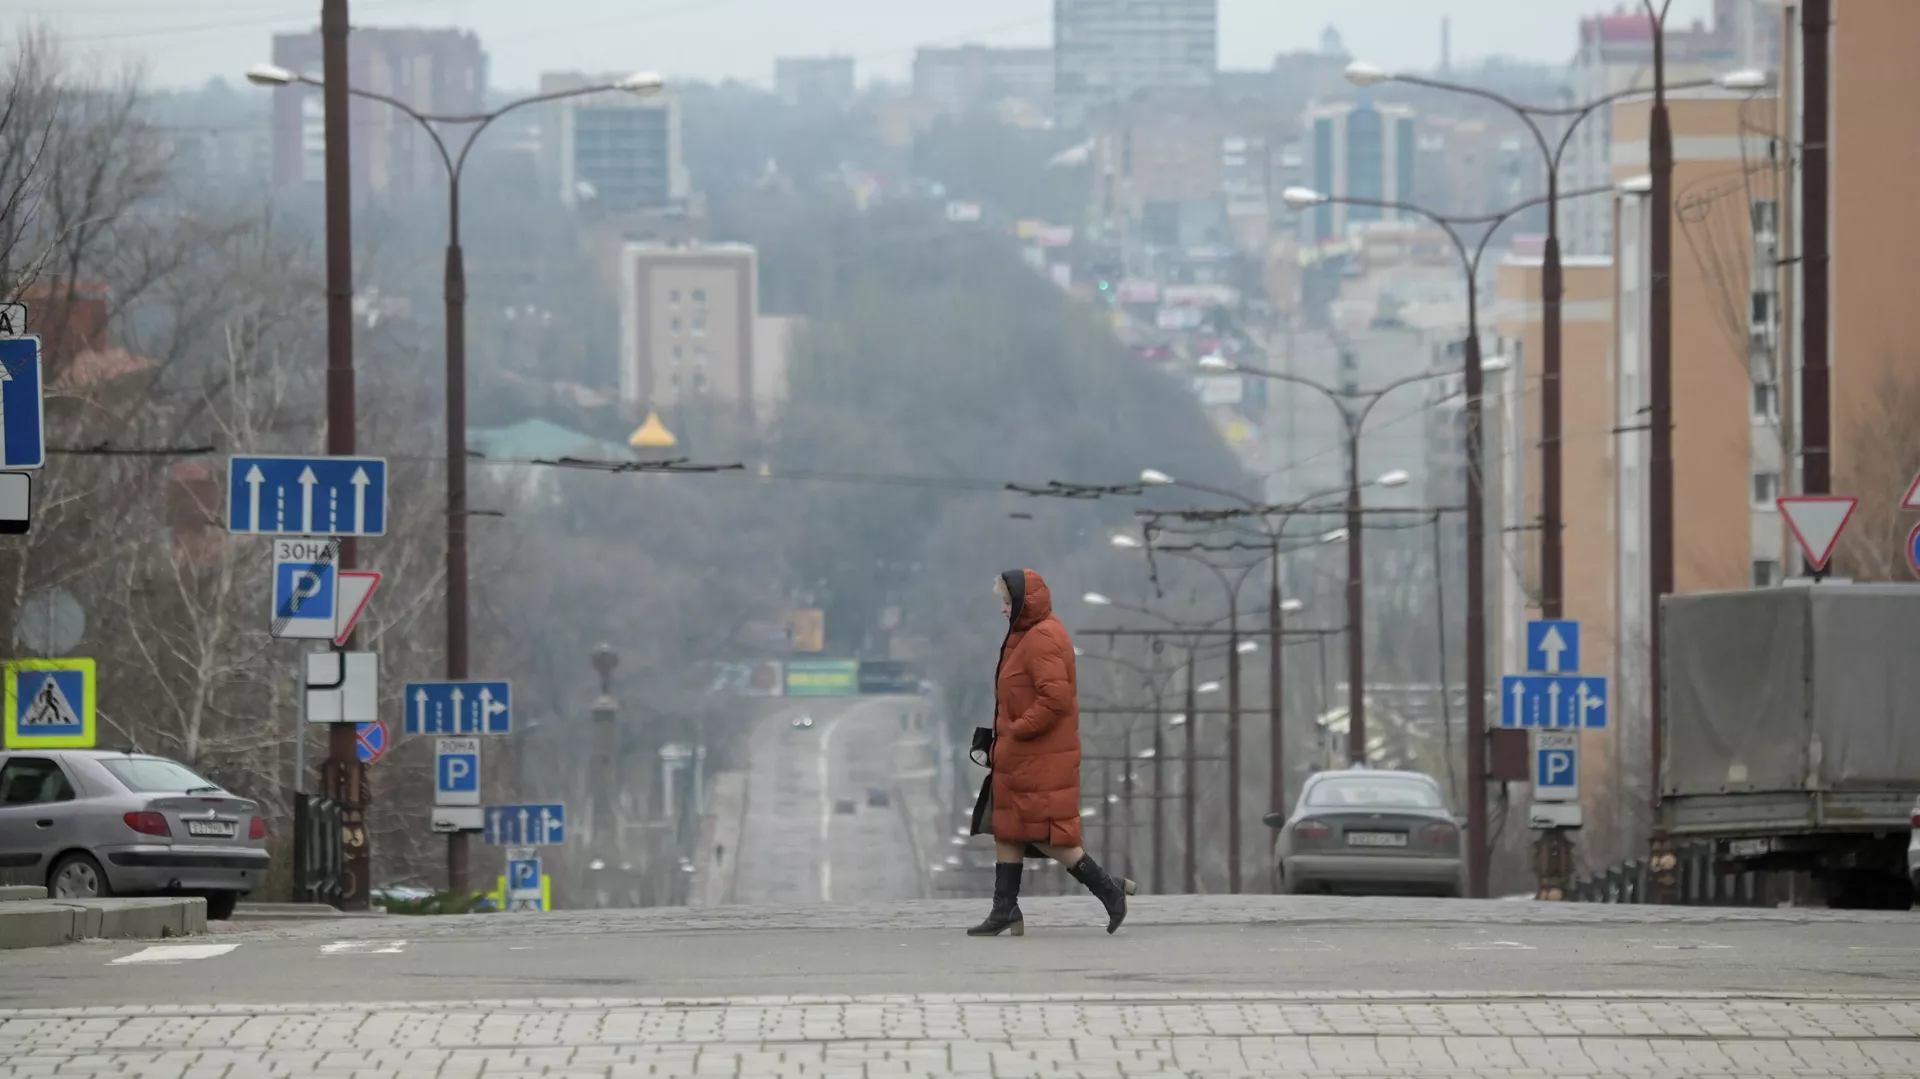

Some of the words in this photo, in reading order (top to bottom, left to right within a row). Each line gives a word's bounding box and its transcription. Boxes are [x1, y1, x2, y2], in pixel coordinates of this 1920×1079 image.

[279, 543, 332, 560] ЗОНА
[290, 570, 321, 613] P
[448, 758, 469, 788] P
[1547, 752, 1569, 784] P
